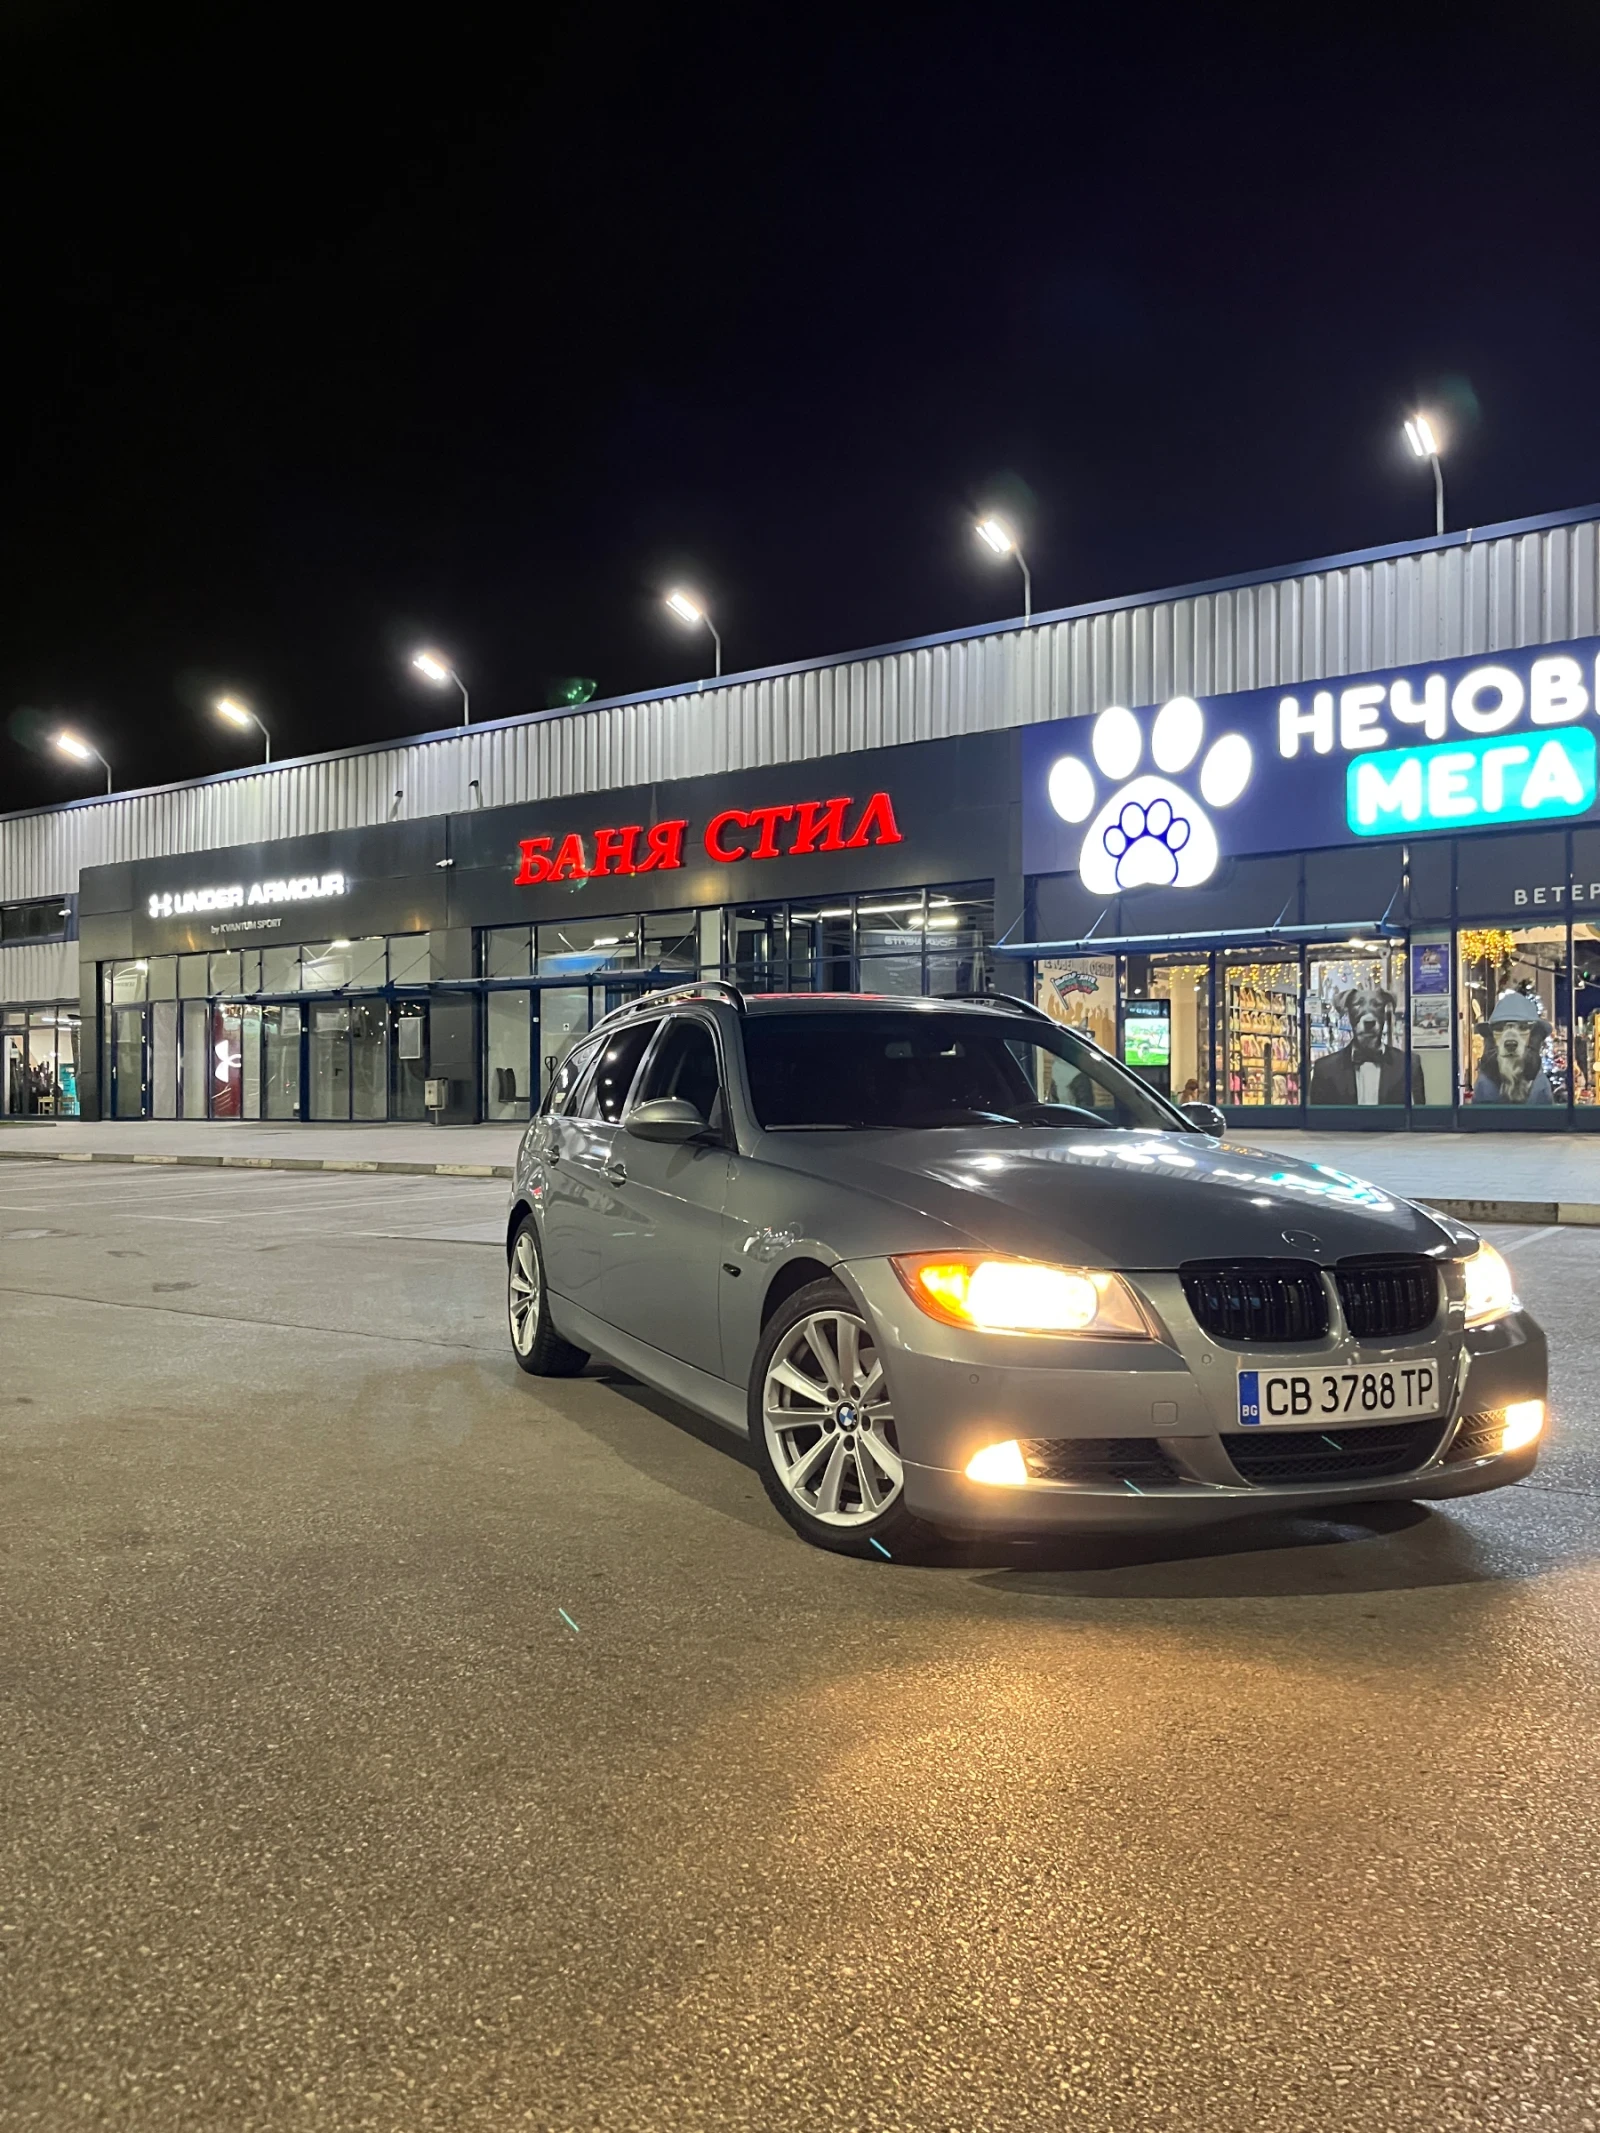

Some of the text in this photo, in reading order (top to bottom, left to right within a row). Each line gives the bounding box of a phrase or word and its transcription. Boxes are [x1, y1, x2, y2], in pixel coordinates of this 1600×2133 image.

[1279, 652, 1600, 758] НЕЧОВ
[1357, 740, 1585, 826] МЕГА
[514, 792, 902, 885] БАНЯ СТИЛ
[174, 871, 345, 914] UNDER ARMOUR
[1514, 883, 1600, 906] ВЕТЕР
[211, 918, 282, 935] by KVANTUM SPORT
[1242, 1404, 1258, 1417] BG
[1266, 1368, 1433, 1415] CB 3788 TP
